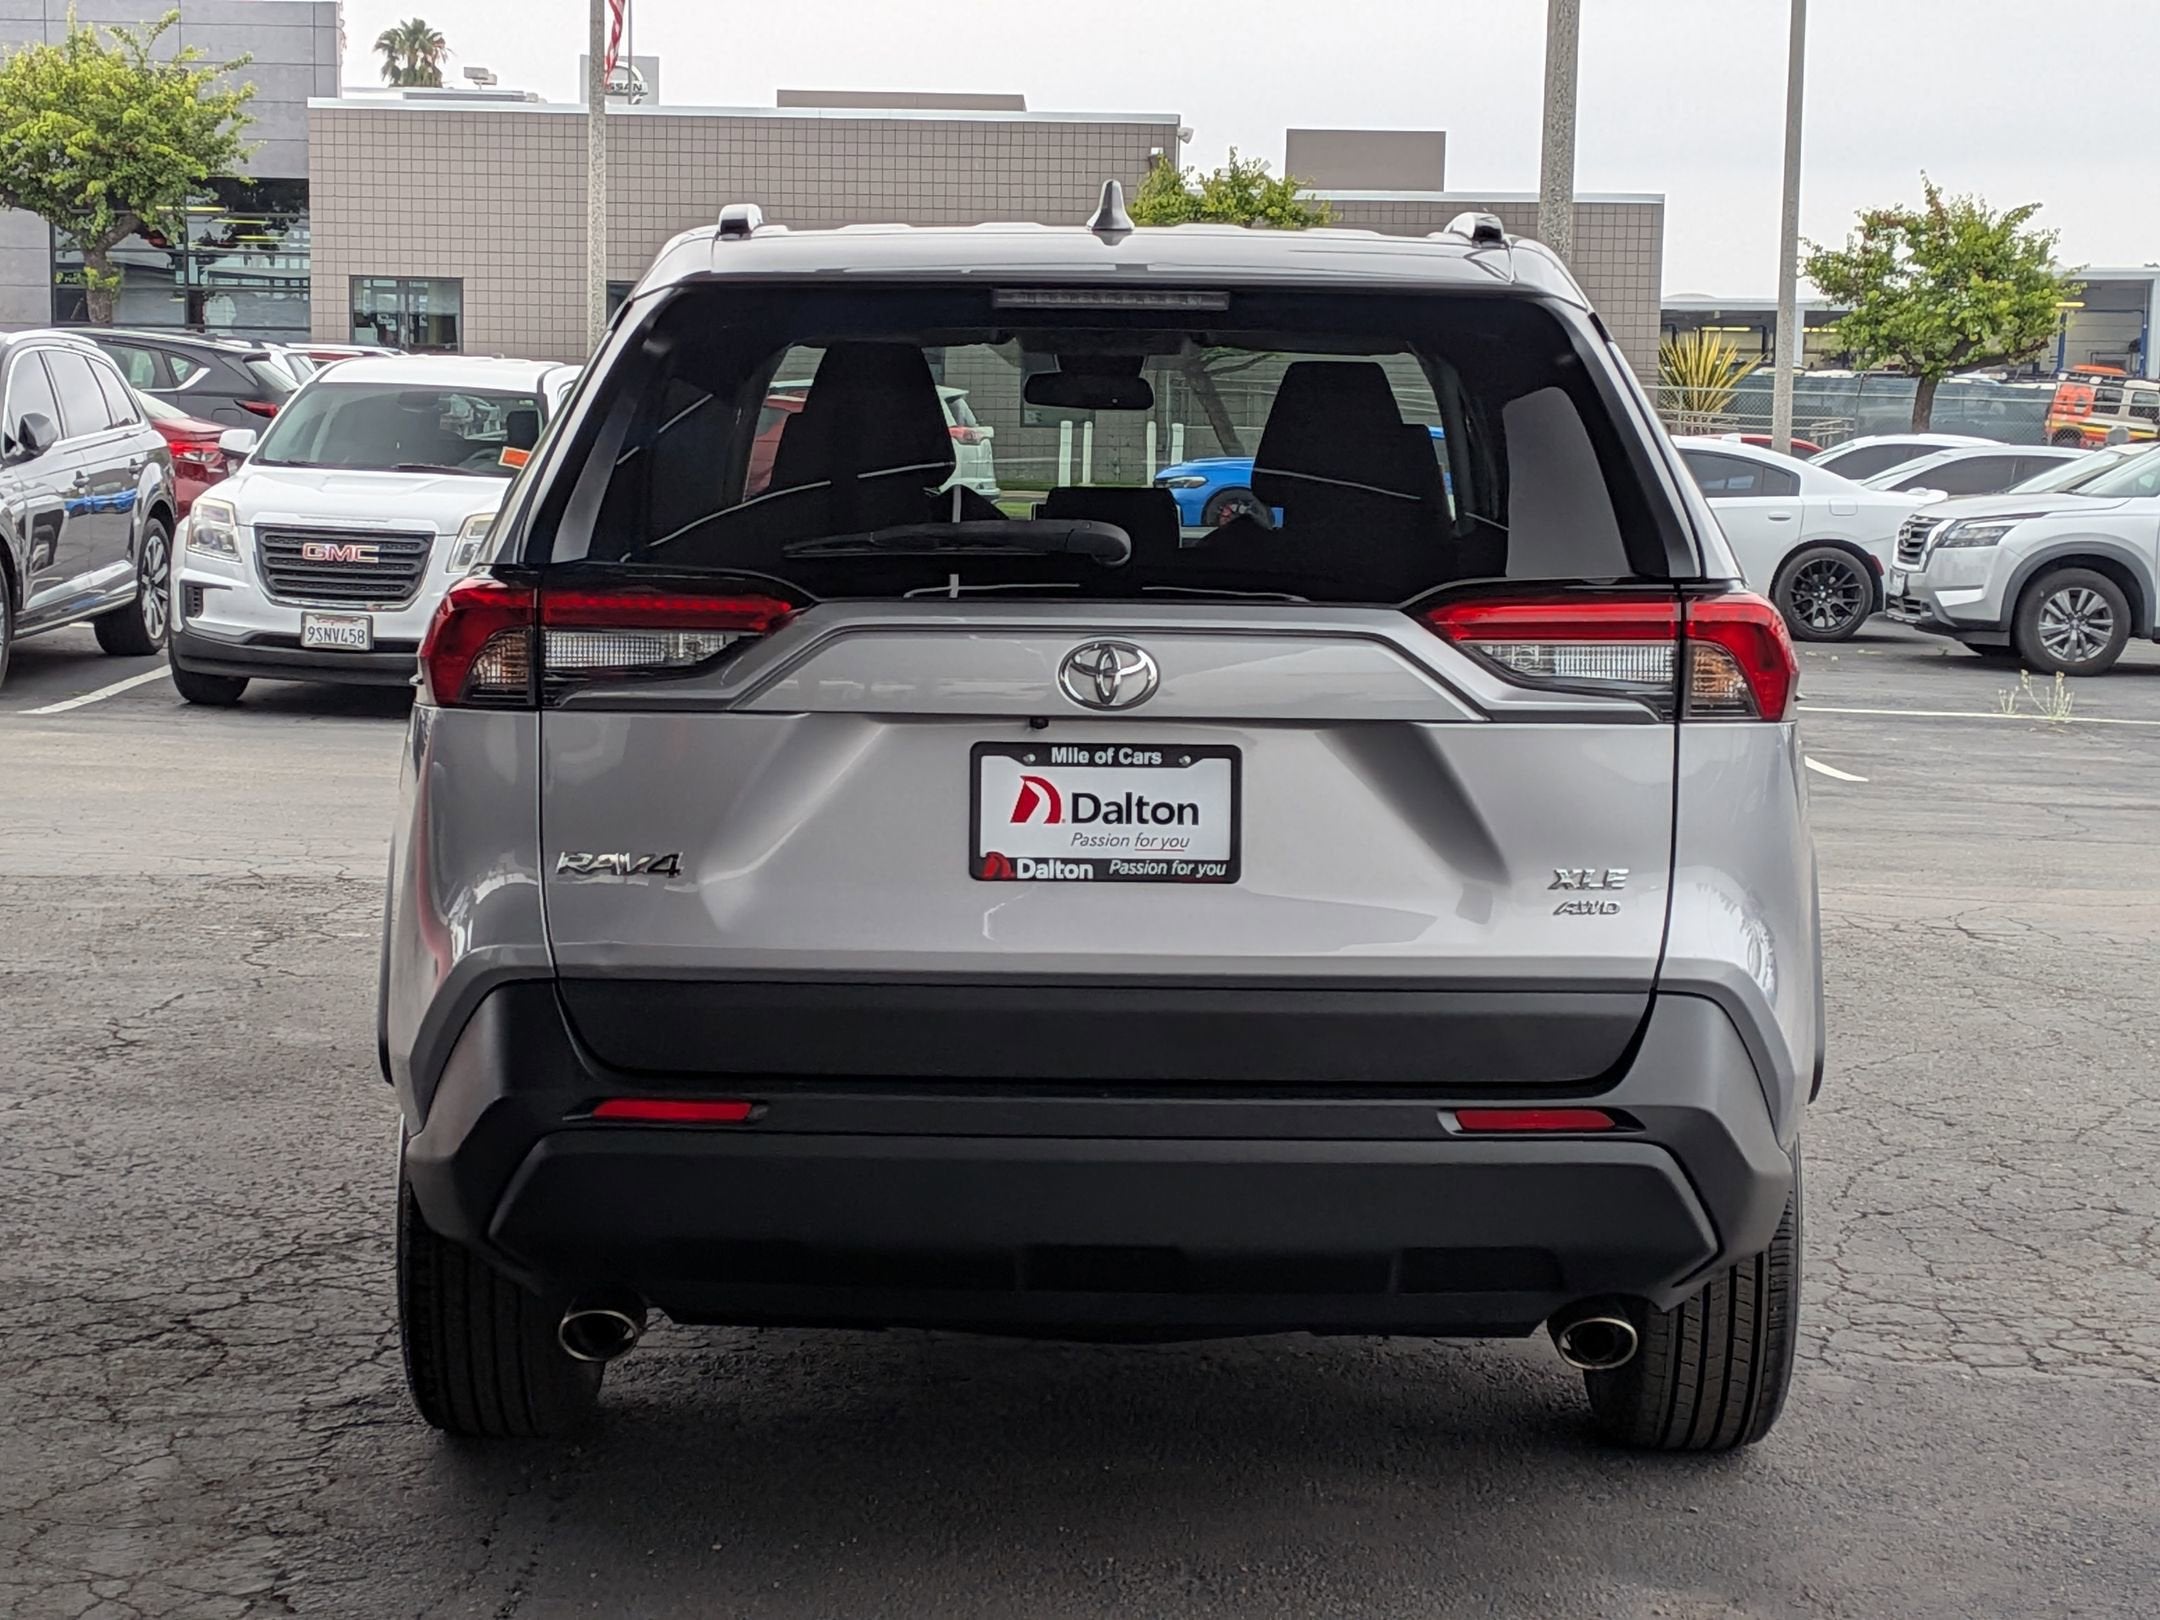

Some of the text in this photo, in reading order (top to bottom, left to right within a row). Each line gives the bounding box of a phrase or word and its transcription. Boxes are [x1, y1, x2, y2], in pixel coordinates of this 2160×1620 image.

[303, 543, 379, 563] GMC
[307, 626, 366, 644] 9SNV458
[1051, 748, 1162, 765] Mile of Cars
[1071, 792, 1199, 825] Dalton
[1070, 833, 1190, 850] Passion for you
[555, 852, 684, 878] RAV4
[1017, 859, 1227, 879] Dalton Passion for you
[1547, 868, 1629, 890] XLE
[1553, 900, 1621, 915] AWD
